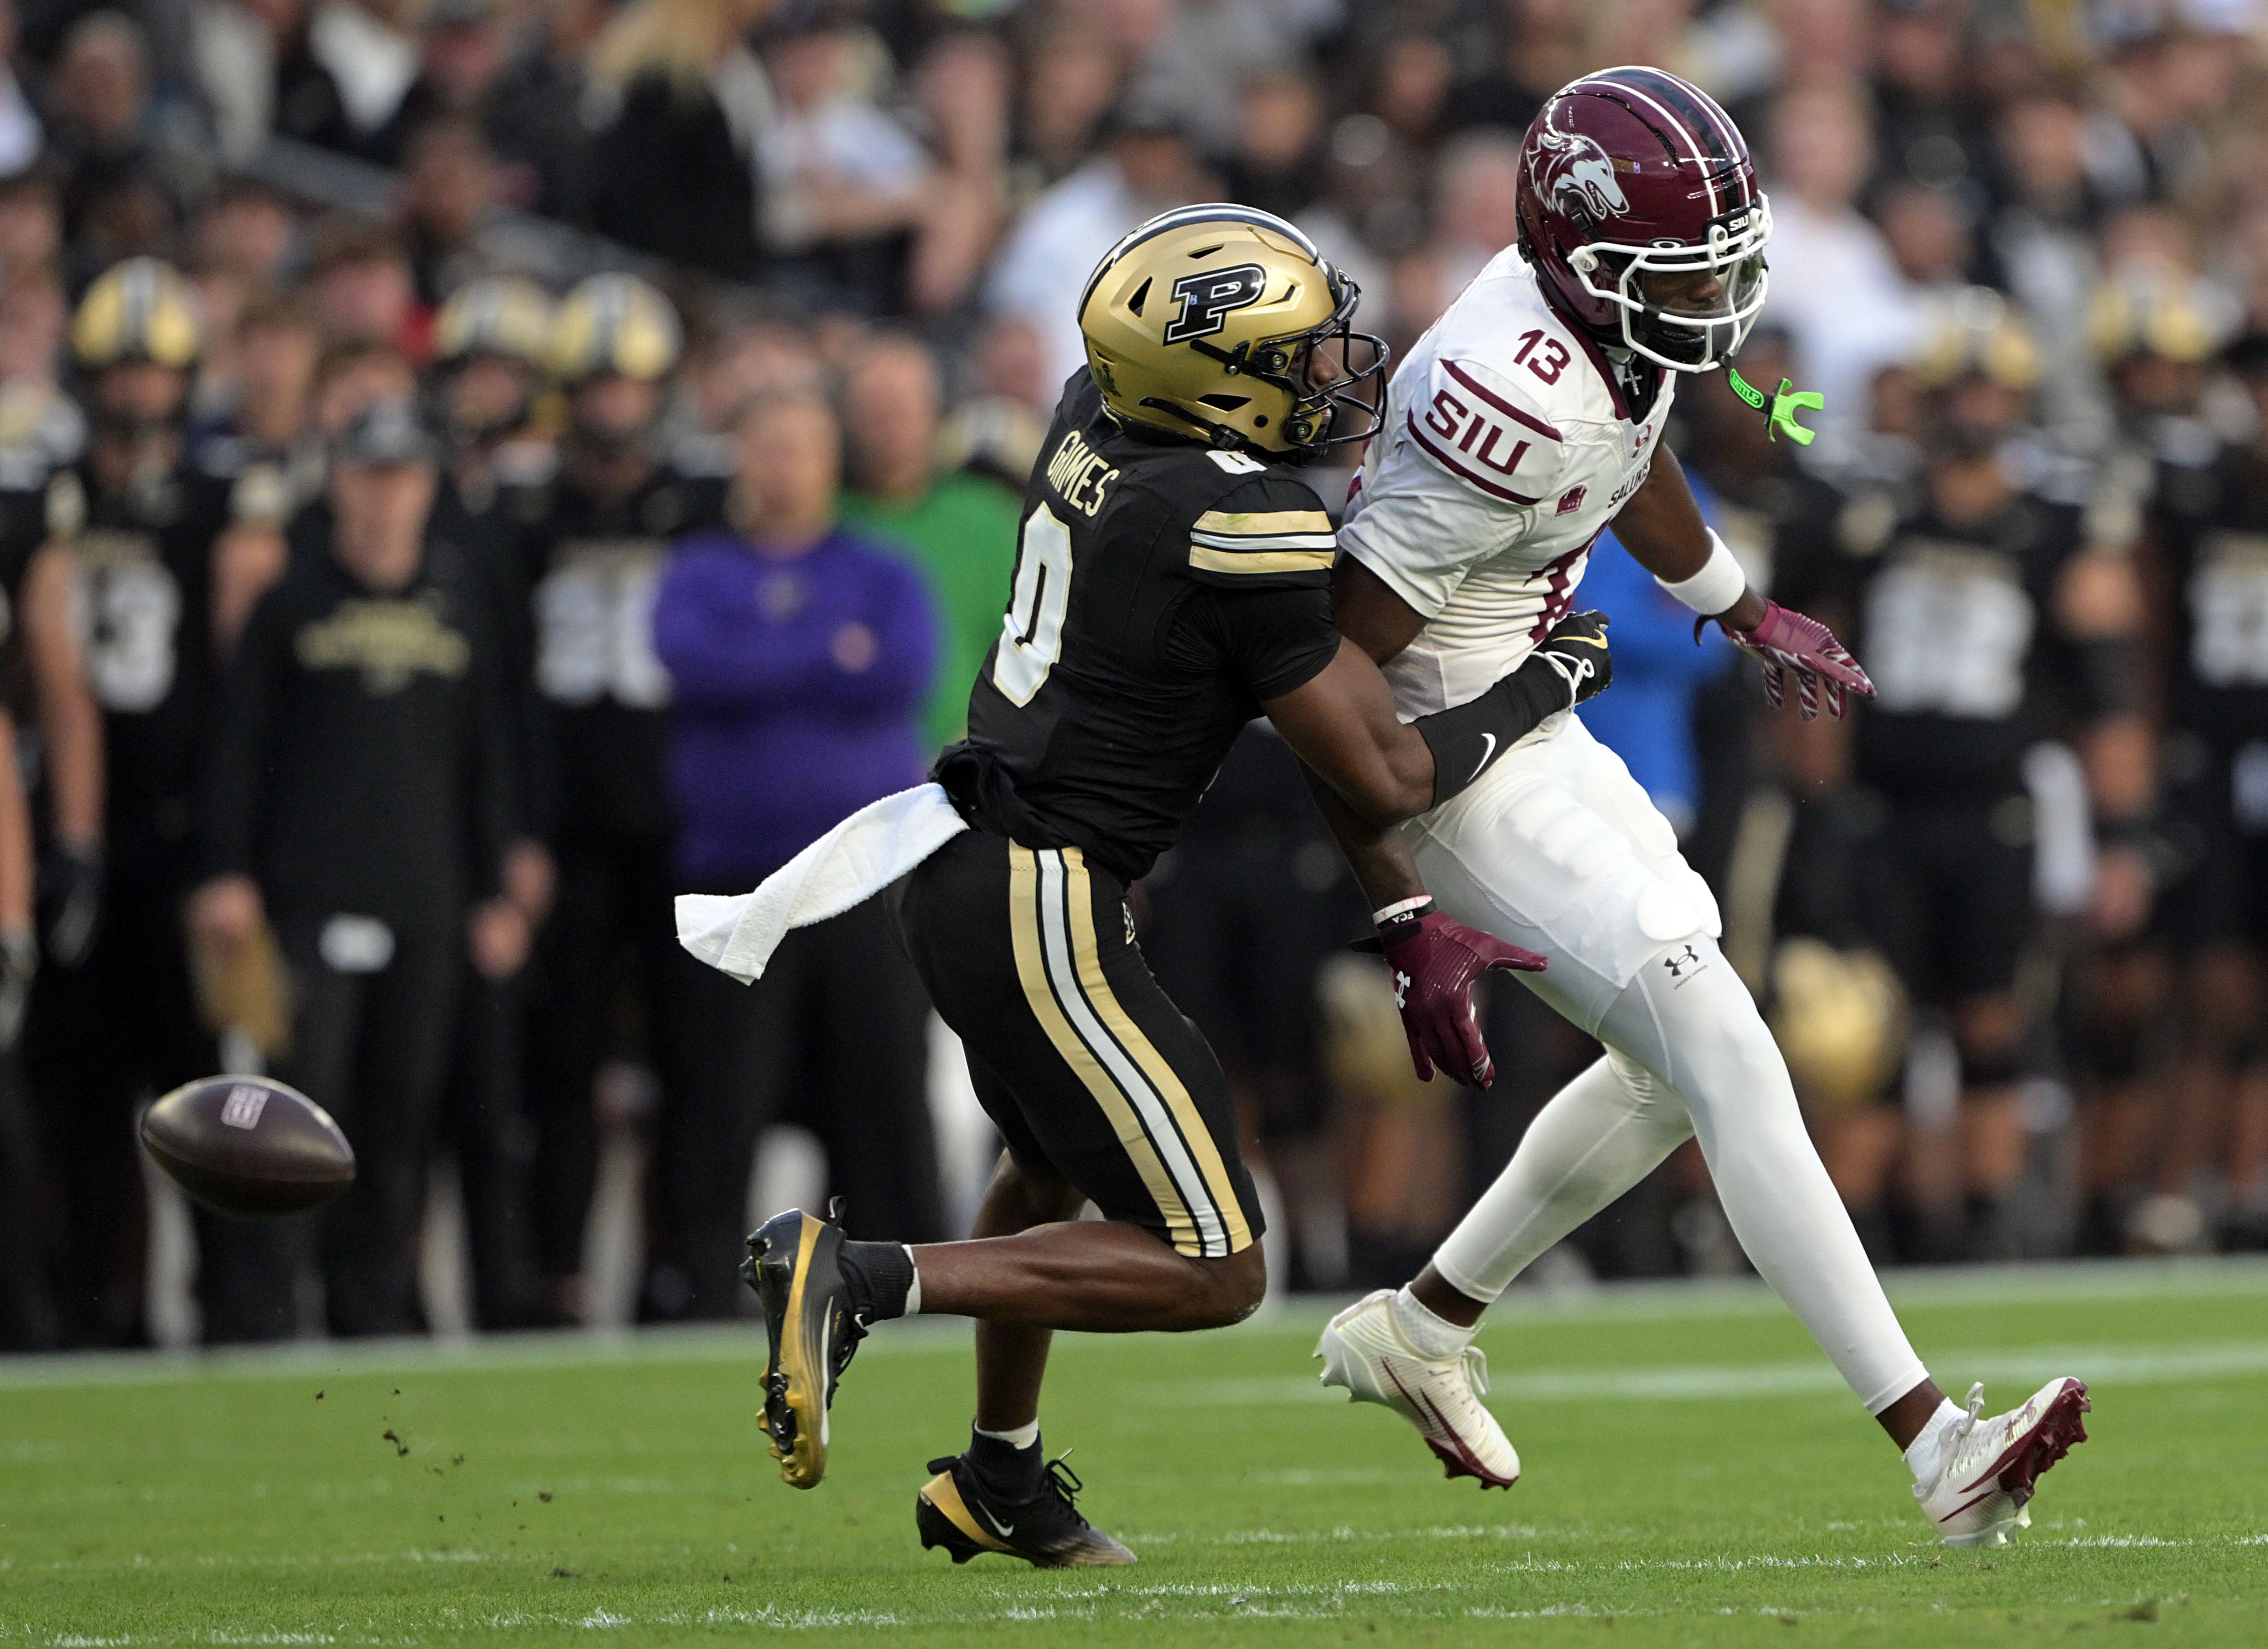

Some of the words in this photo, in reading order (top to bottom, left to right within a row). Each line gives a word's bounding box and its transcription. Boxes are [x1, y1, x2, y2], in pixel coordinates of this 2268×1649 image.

[1729, 215, 1748, 231] SIU
[1163, 263, 1267, 346] P
[1513, 329, 1571, 386] 13
[1425, 389, 1531, 476] SIU
[993, 501, 1074, 708] 0
[1392, 911, 1414, 924] FCA
